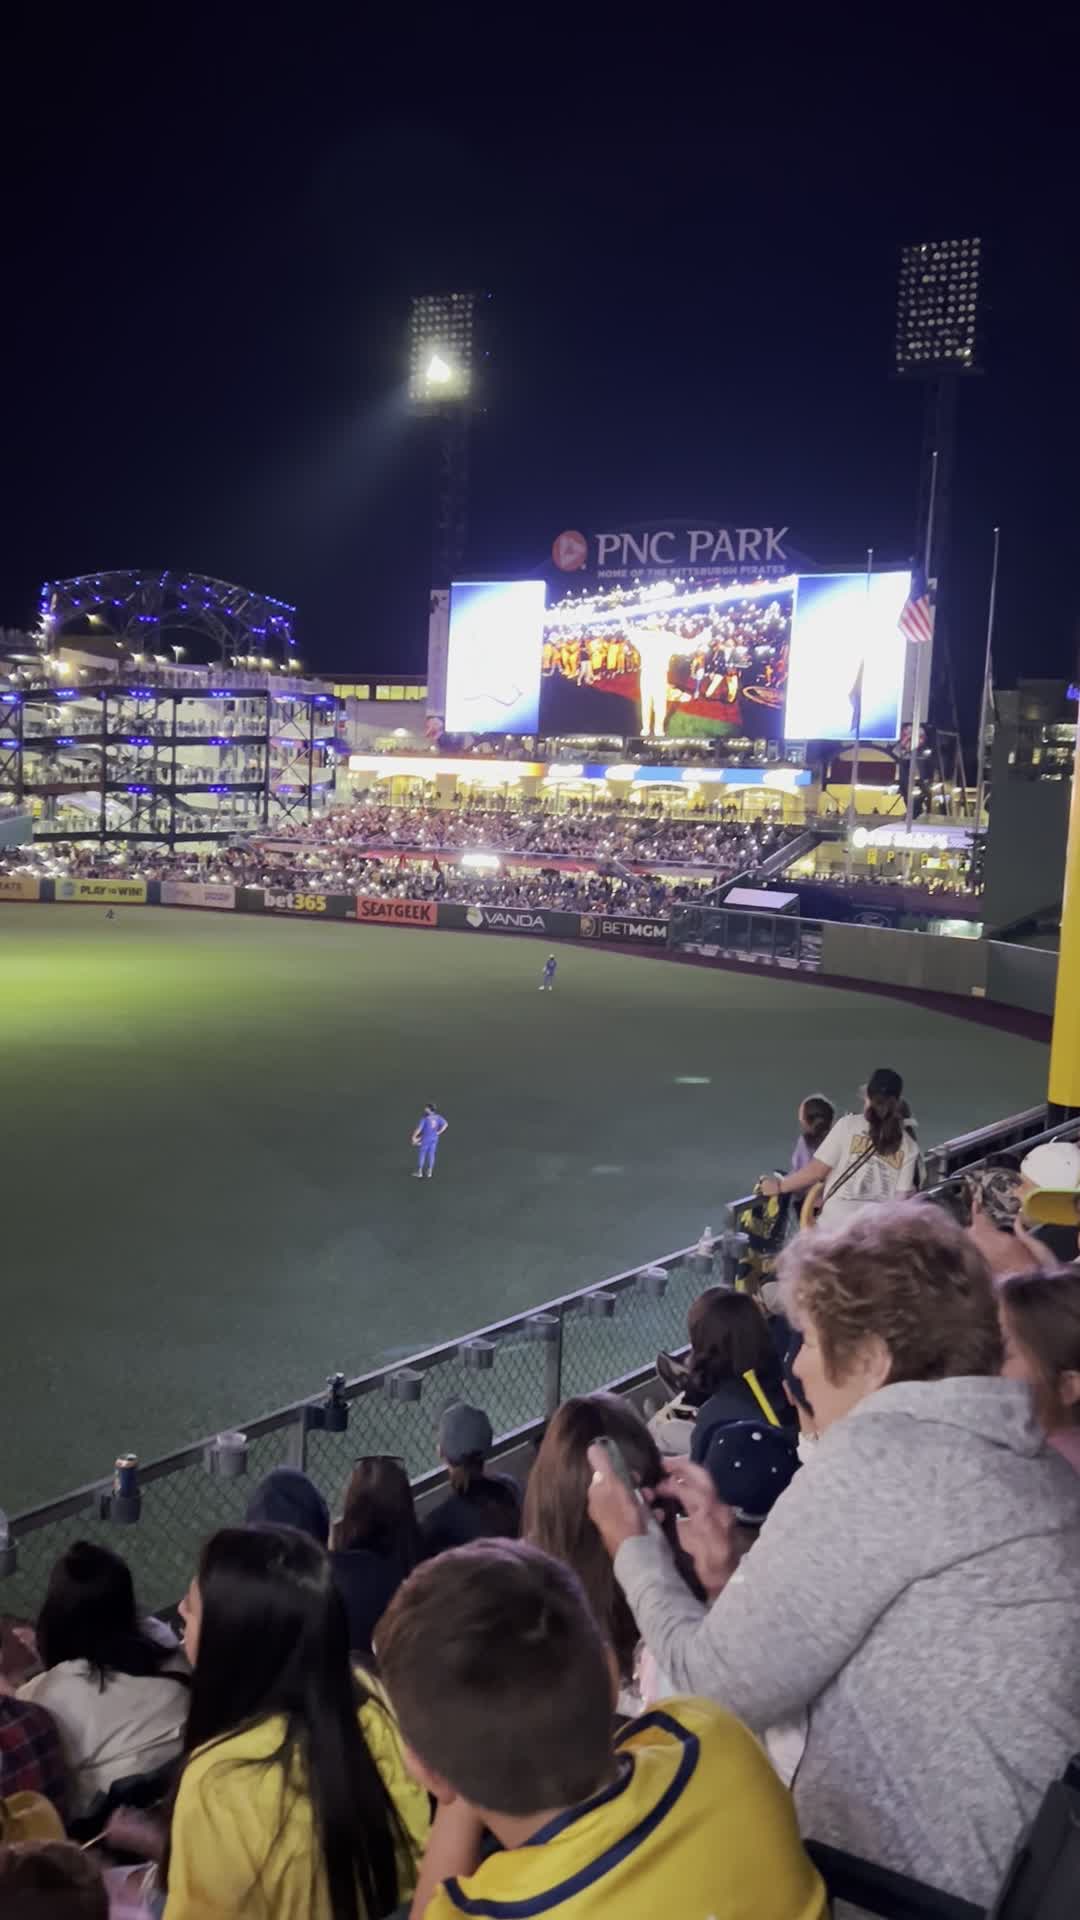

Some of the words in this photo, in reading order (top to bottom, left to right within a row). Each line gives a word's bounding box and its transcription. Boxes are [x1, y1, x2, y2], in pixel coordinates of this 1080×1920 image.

[594, 531, 676, 565] PNC
[687, 527, 789, 562] PARK
[597, 569, 627, 578] HOME
[630, 569, 643, 577] OF
[648, 568, 670, 577] THE
[672, 566, 737, 577] PITTSBURGH
[740, 565, 786, 575] PIRATES
[80, 885, 106, 895] PLAY
[264, 889, 327, 911] bet365
[361, 900, 431, 922] SEATGEEK
[483, 913, 545, 929] VANDA
[602, 921, 667, 938] BETMGM
